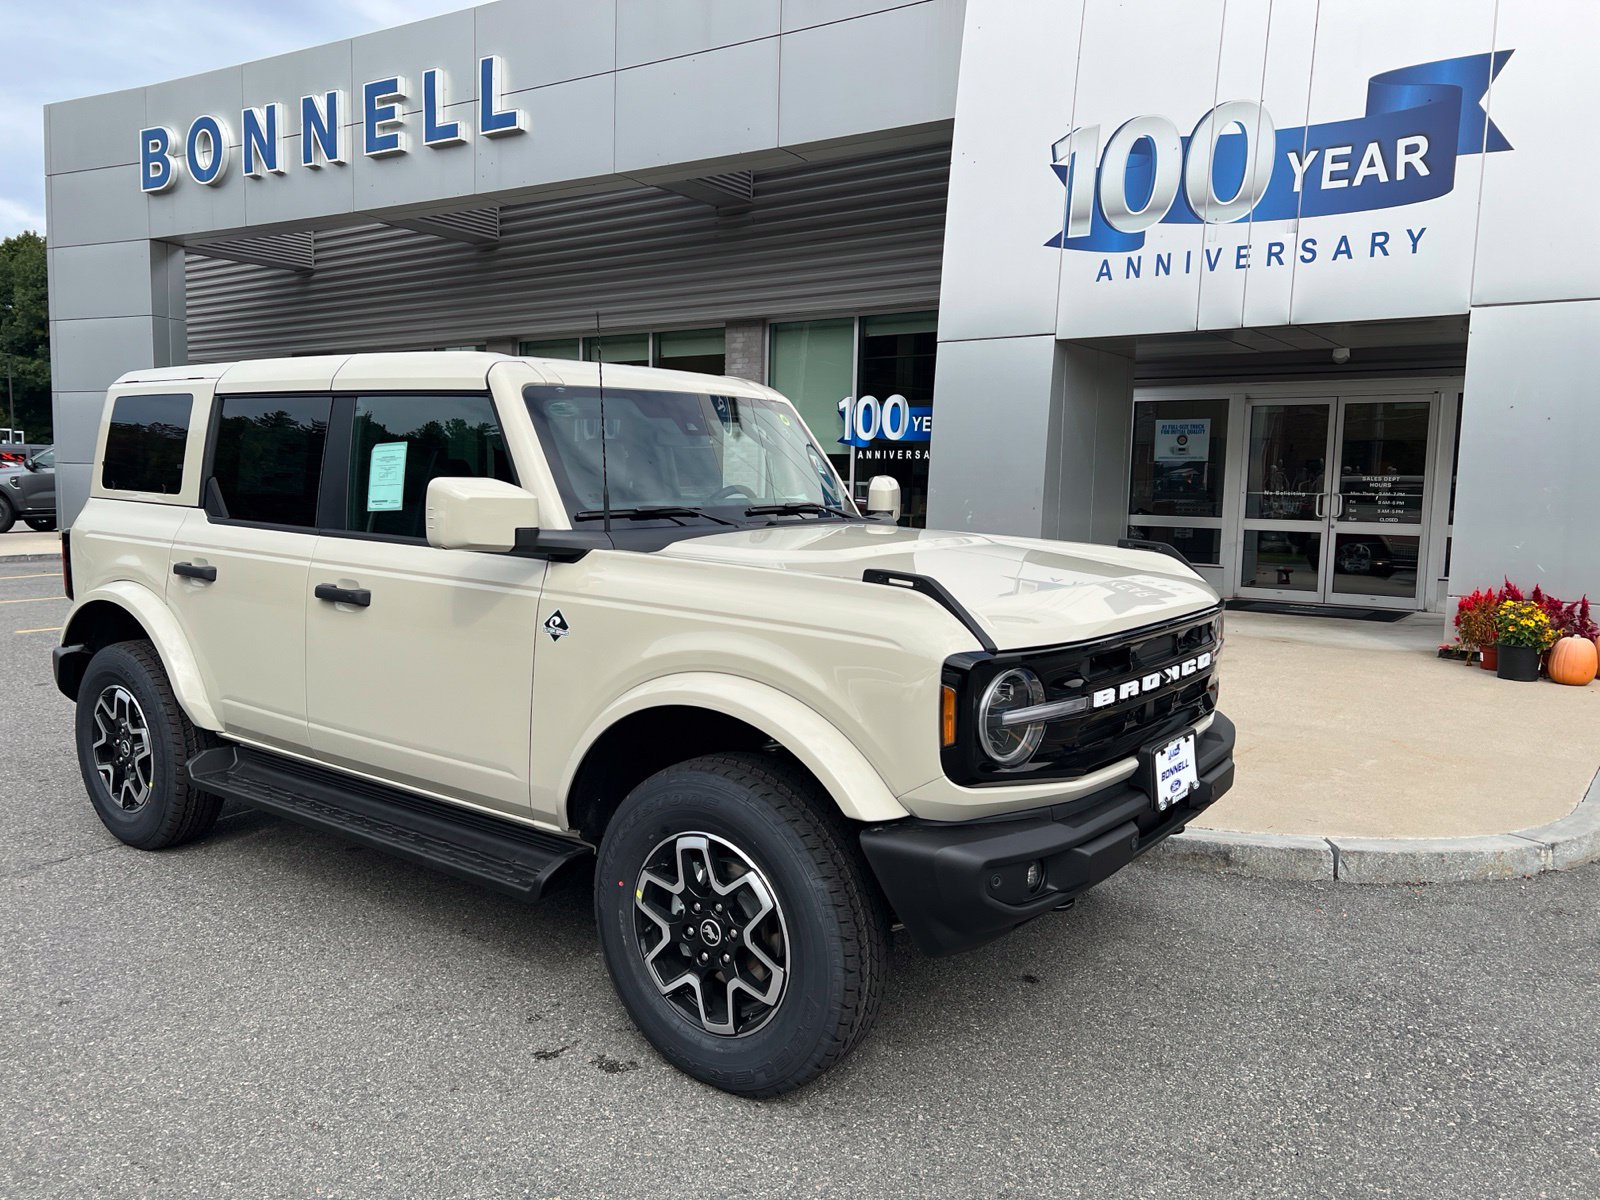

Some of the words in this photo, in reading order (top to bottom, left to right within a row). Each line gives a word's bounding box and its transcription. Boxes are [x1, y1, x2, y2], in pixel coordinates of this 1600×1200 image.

[139, 54, 526, 194] BONNELL
[1050, 98, 1277, 239] 100
[1286, 134, 1431, 193] YEAR
[1095, 226, 1428, 283] ANNIVERSARY
[837, 393, 910, 441] 100
[912, 416, 932, 432] YE
[857, 450, 930, 459] ANNIVERSA
[1093, 652, 1211, 708] BRONCO
[1160, 758, 1190, 782] BONNELL
